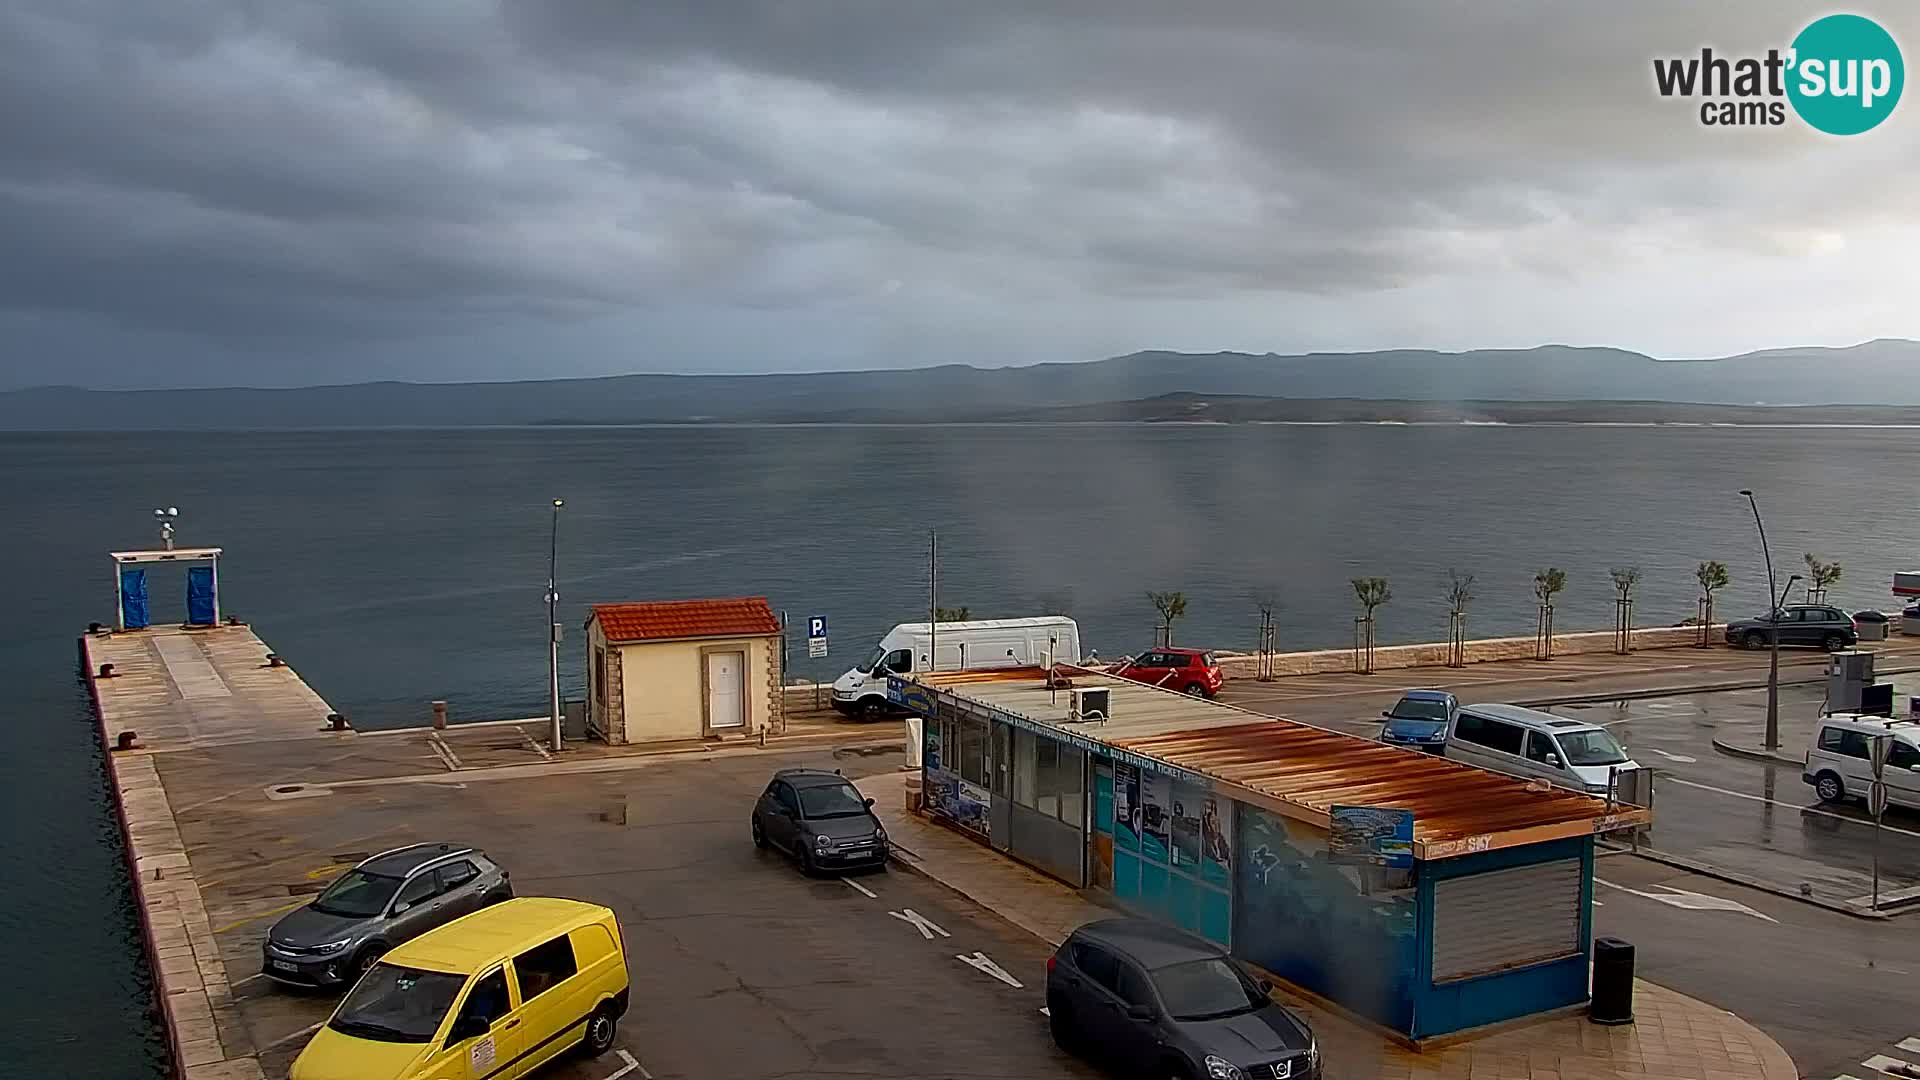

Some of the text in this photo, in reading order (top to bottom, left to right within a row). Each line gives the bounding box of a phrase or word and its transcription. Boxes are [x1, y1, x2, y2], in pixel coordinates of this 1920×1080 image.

[812, 619, 823, 636] P
[1072, 736, 1101, 752] POSTAJA
[1110, 748, 1123, 761] BUS
[1125, 752, 1155, 770] STATION
[1156, 763, 1181, 779] TICKET
